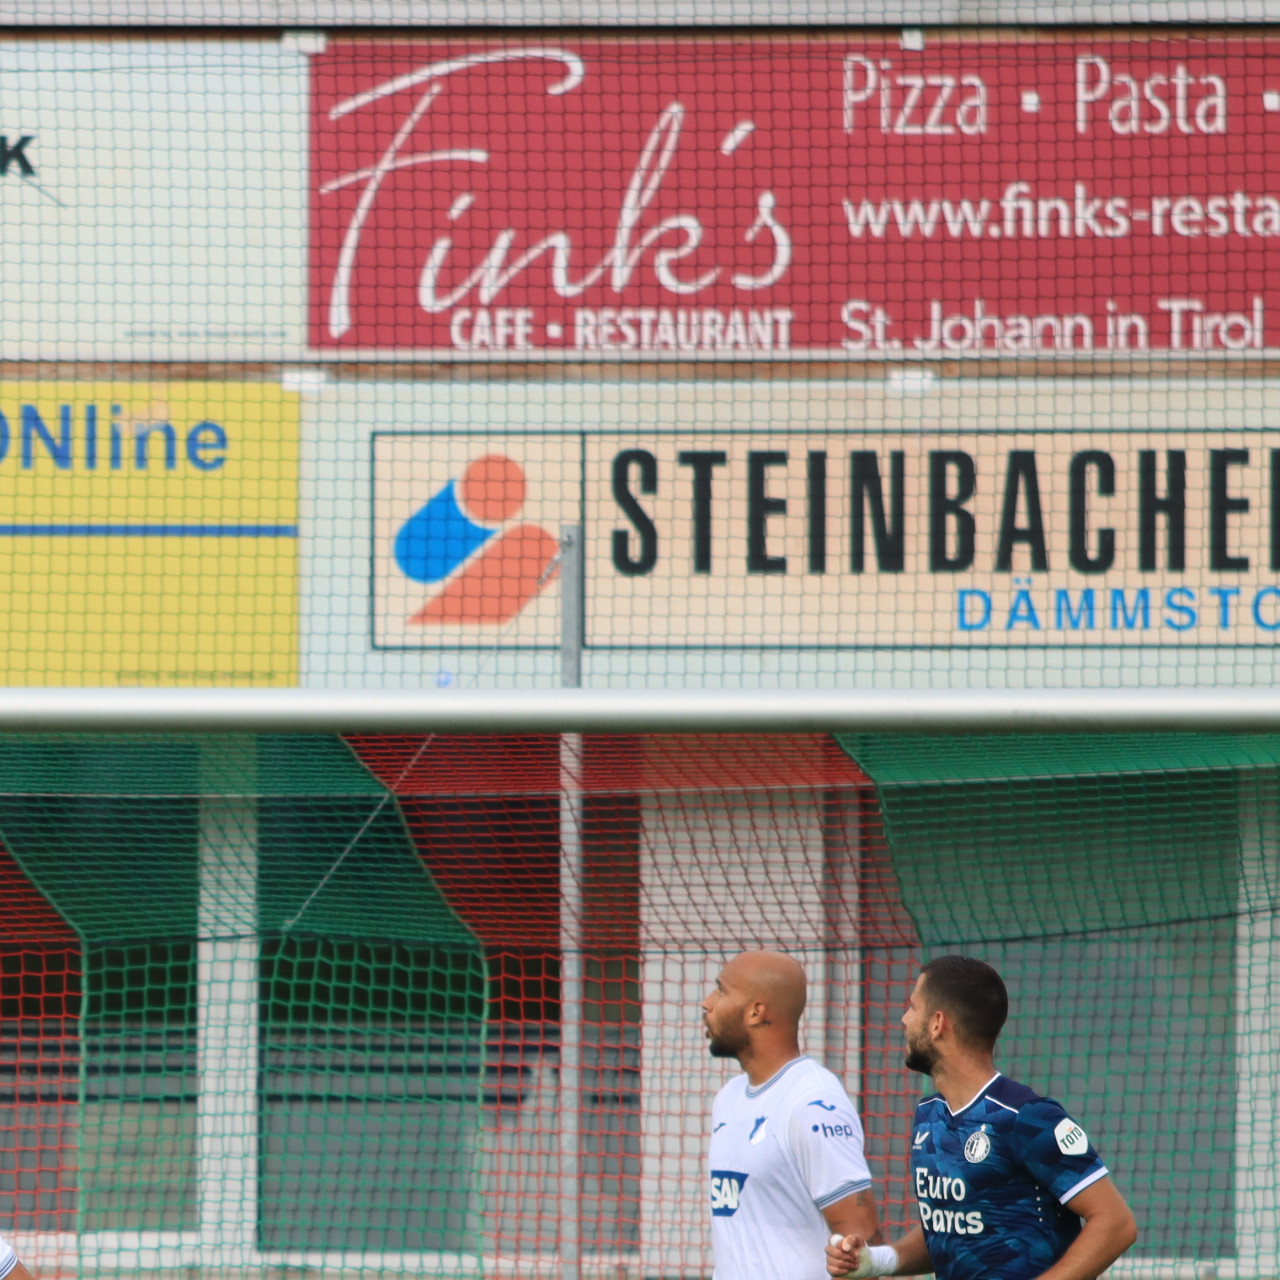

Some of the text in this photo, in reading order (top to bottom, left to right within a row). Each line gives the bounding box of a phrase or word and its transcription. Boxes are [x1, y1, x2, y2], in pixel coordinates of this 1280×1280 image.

[843, 54, 1228, 134] Pizza Pasta
[450, 309, 794, 350] CAFE RESTAURANT
[841, 296, 1264, 350] St. Johann in Tirol
[611, 449, 1280, 577] STEINBACHE
[821, 1123, 853, 1139] hep
[1059, 1126, 1083, 1149] TOTO
[711, 1178, 740, 1209] SAP
[915, 1167, 966, 1201] Euro
[918, 1202, 984, 1235] Parcs
